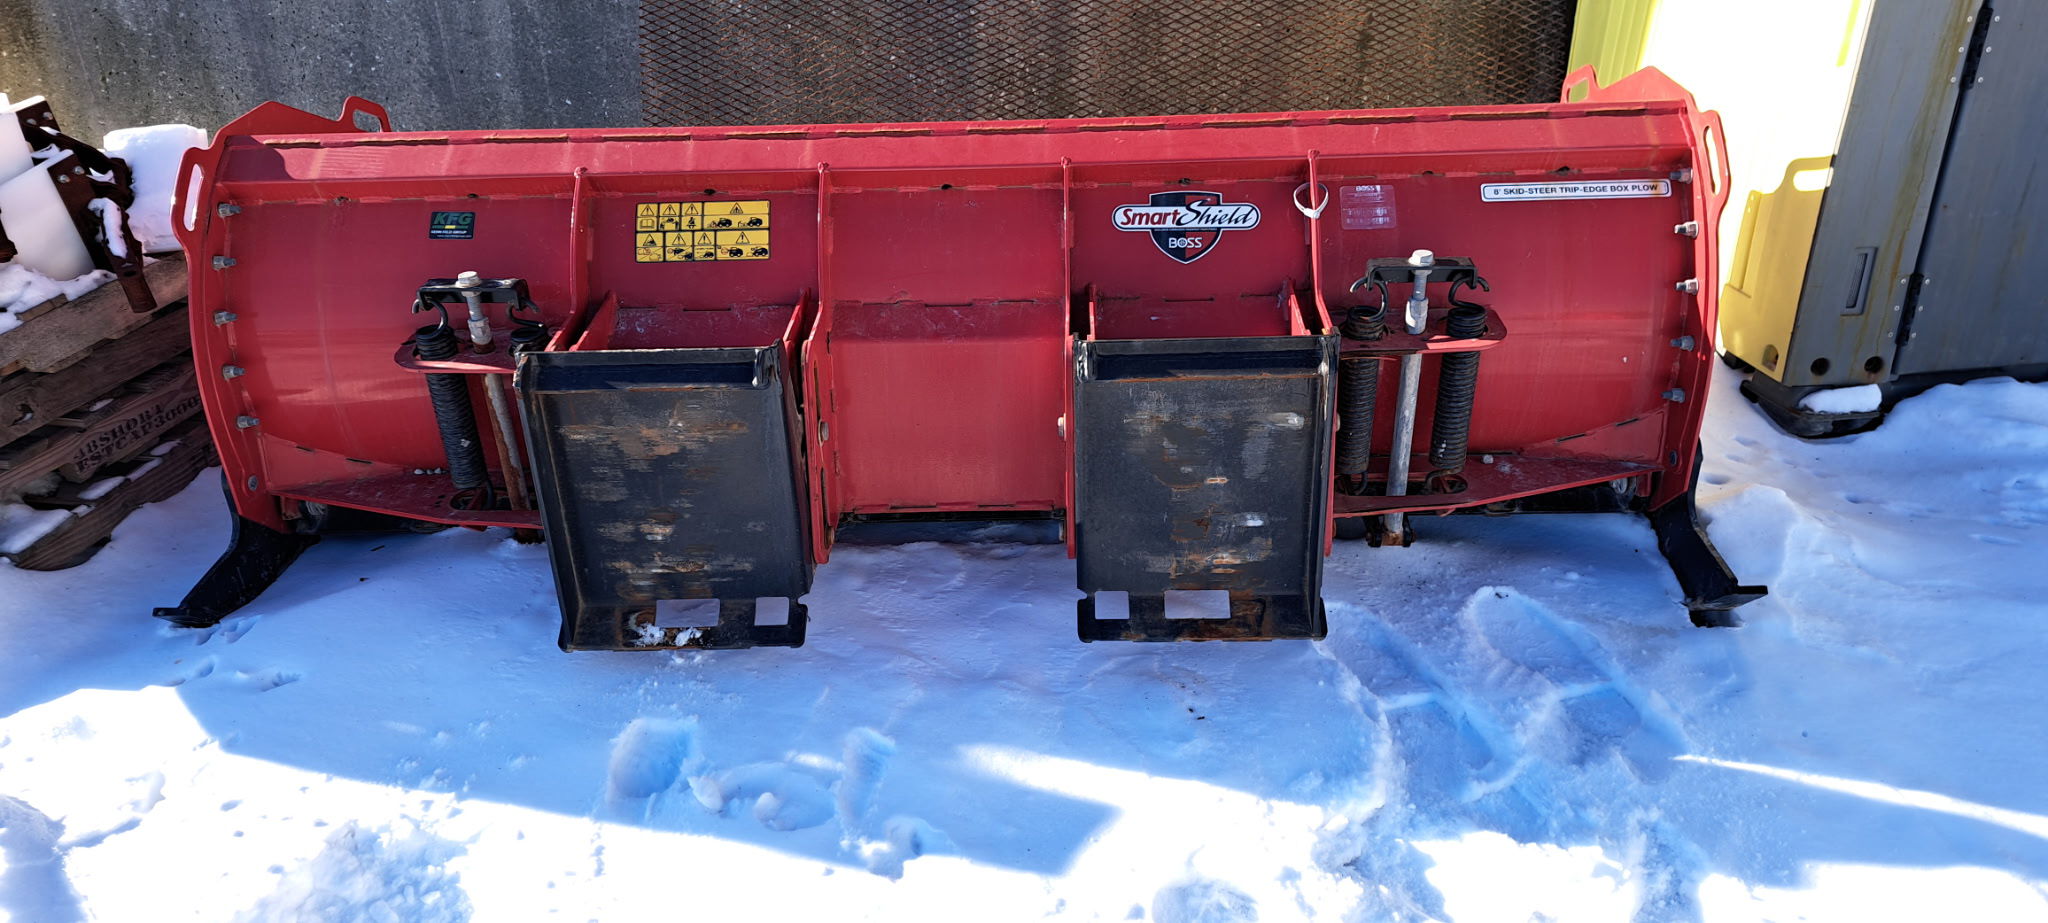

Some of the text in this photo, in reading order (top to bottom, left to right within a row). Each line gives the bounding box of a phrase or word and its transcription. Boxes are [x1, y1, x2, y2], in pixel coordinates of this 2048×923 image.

[1503, 187, 1557, 195] SKID-STEER
[1559, 185, 1608, 193] TRIP-EDGE
[433, 212, 473, 224] KFG
[1168, 236, 1203, 249] BOSS
